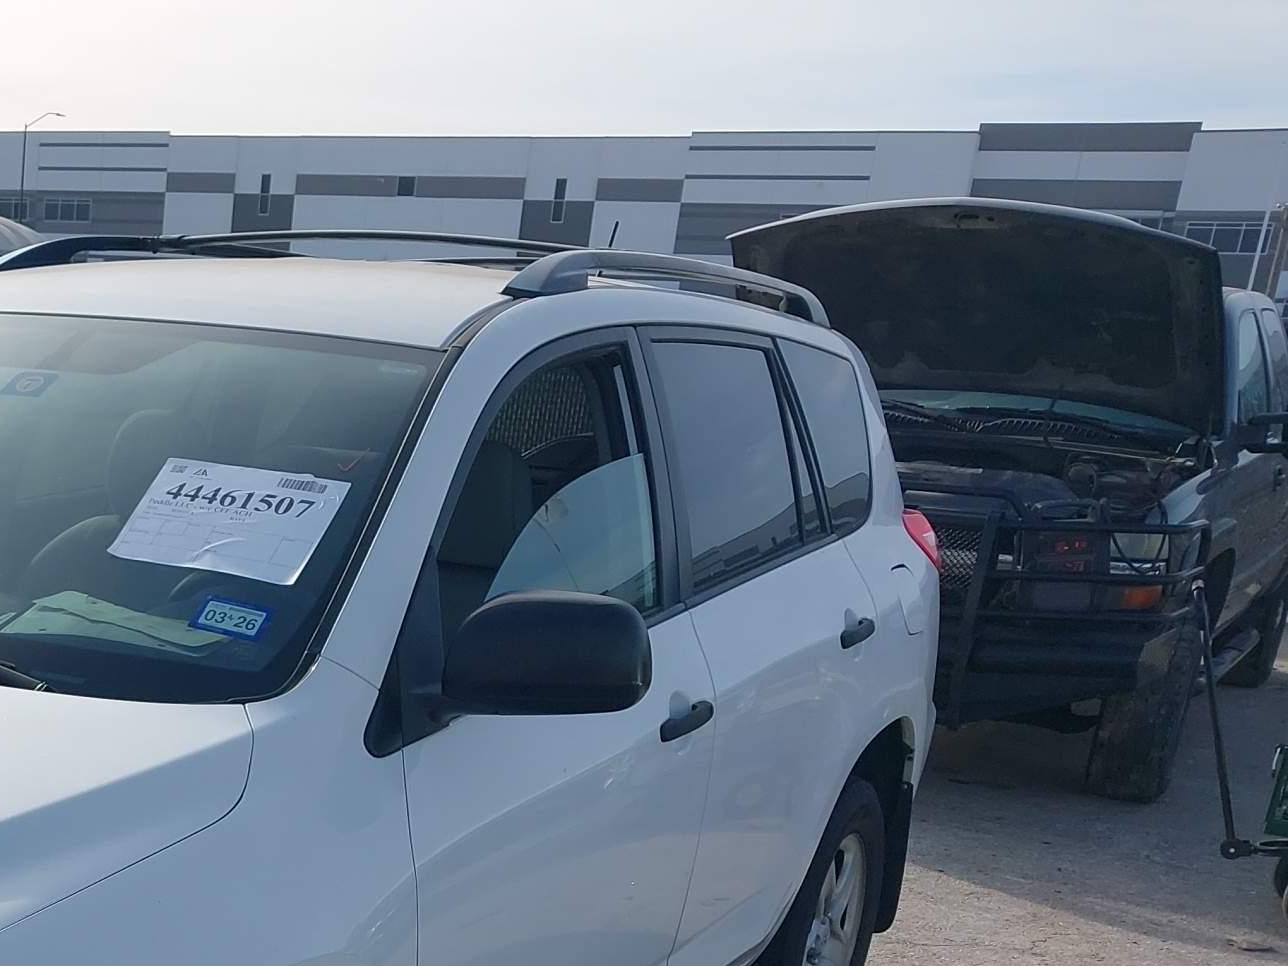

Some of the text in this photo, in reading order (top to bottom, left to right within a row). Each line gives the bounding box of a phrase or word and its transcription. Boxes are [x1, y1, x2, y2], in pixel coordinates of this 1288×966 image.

[166, 482, 316, 519] 44461507
[204, 609, 258, 631] 03 26
